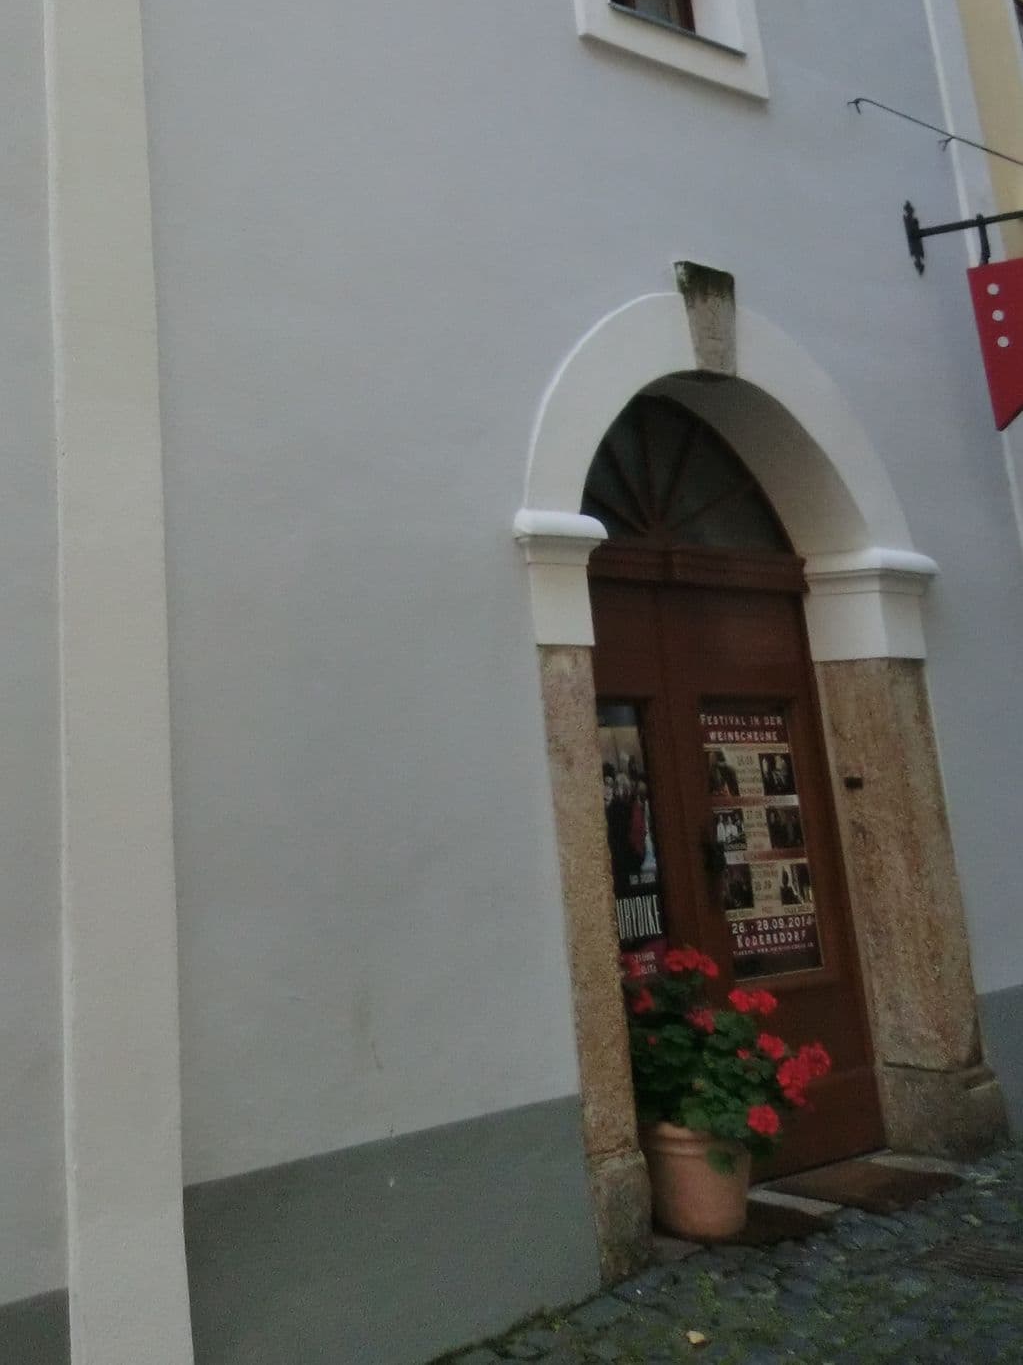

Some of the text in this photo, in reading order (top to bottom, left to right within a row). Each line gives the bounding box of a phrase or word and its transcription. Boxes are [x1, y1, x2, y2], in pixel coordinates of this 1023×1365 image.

[699, 714, 783, 726] FESTIVAL IN DER
[709, 731, 778, 742] WEINSCHEUNE
[616, 894, 662, 940] URYDIKE
